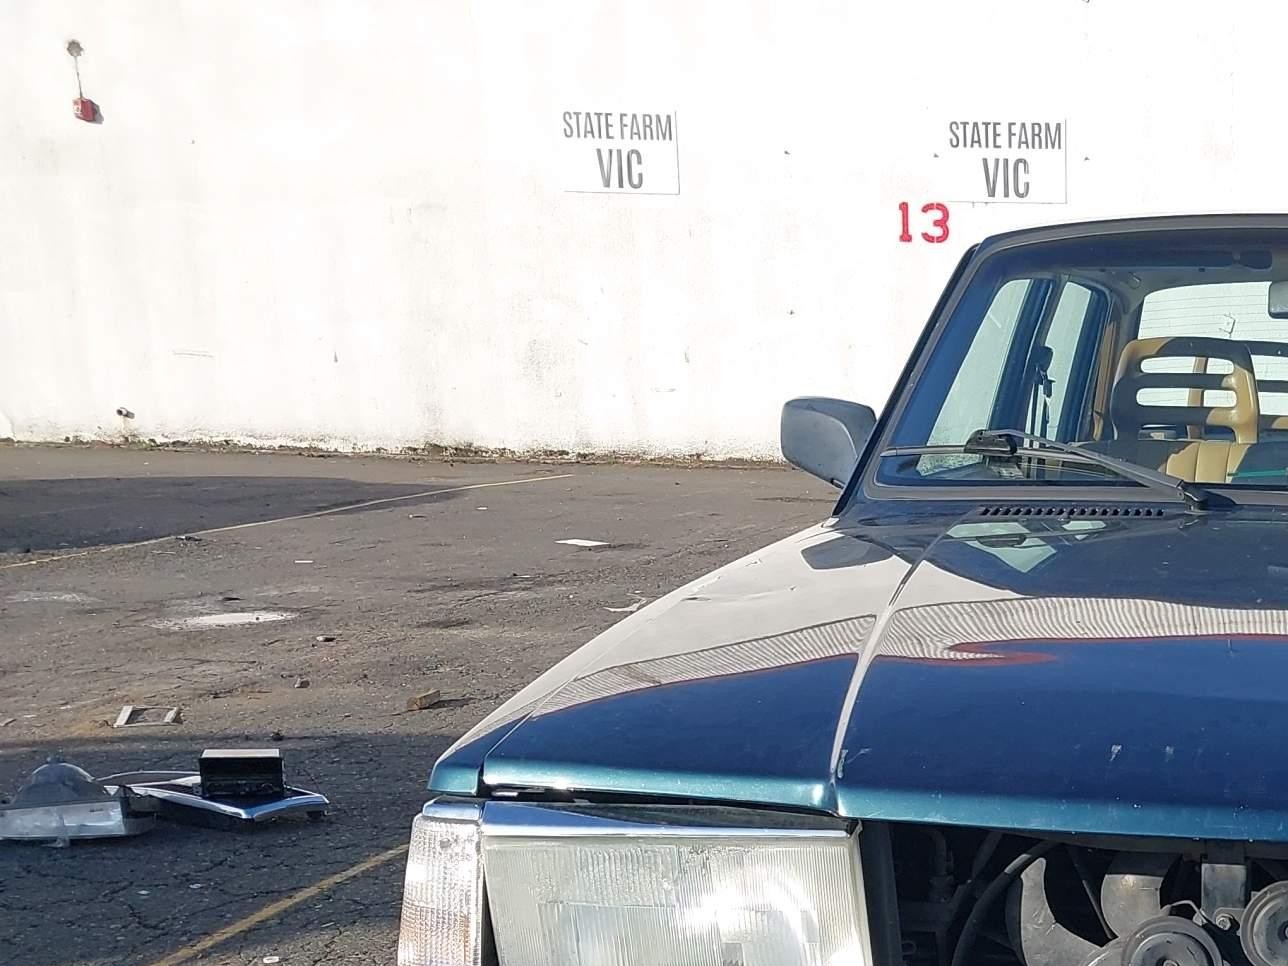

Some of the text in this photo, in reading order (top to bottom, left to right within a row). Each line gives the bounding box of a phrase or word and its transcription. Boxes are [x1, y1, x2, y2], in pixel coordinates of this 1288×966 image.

[563, 111, 674, 141] STATE FARM
[949, 121, 1062, 150] STATE FARM
[596, 148, 644, 189] VIC
[982, 157, 1030, 199] VIC
[898, 201, 950, 244] 13
